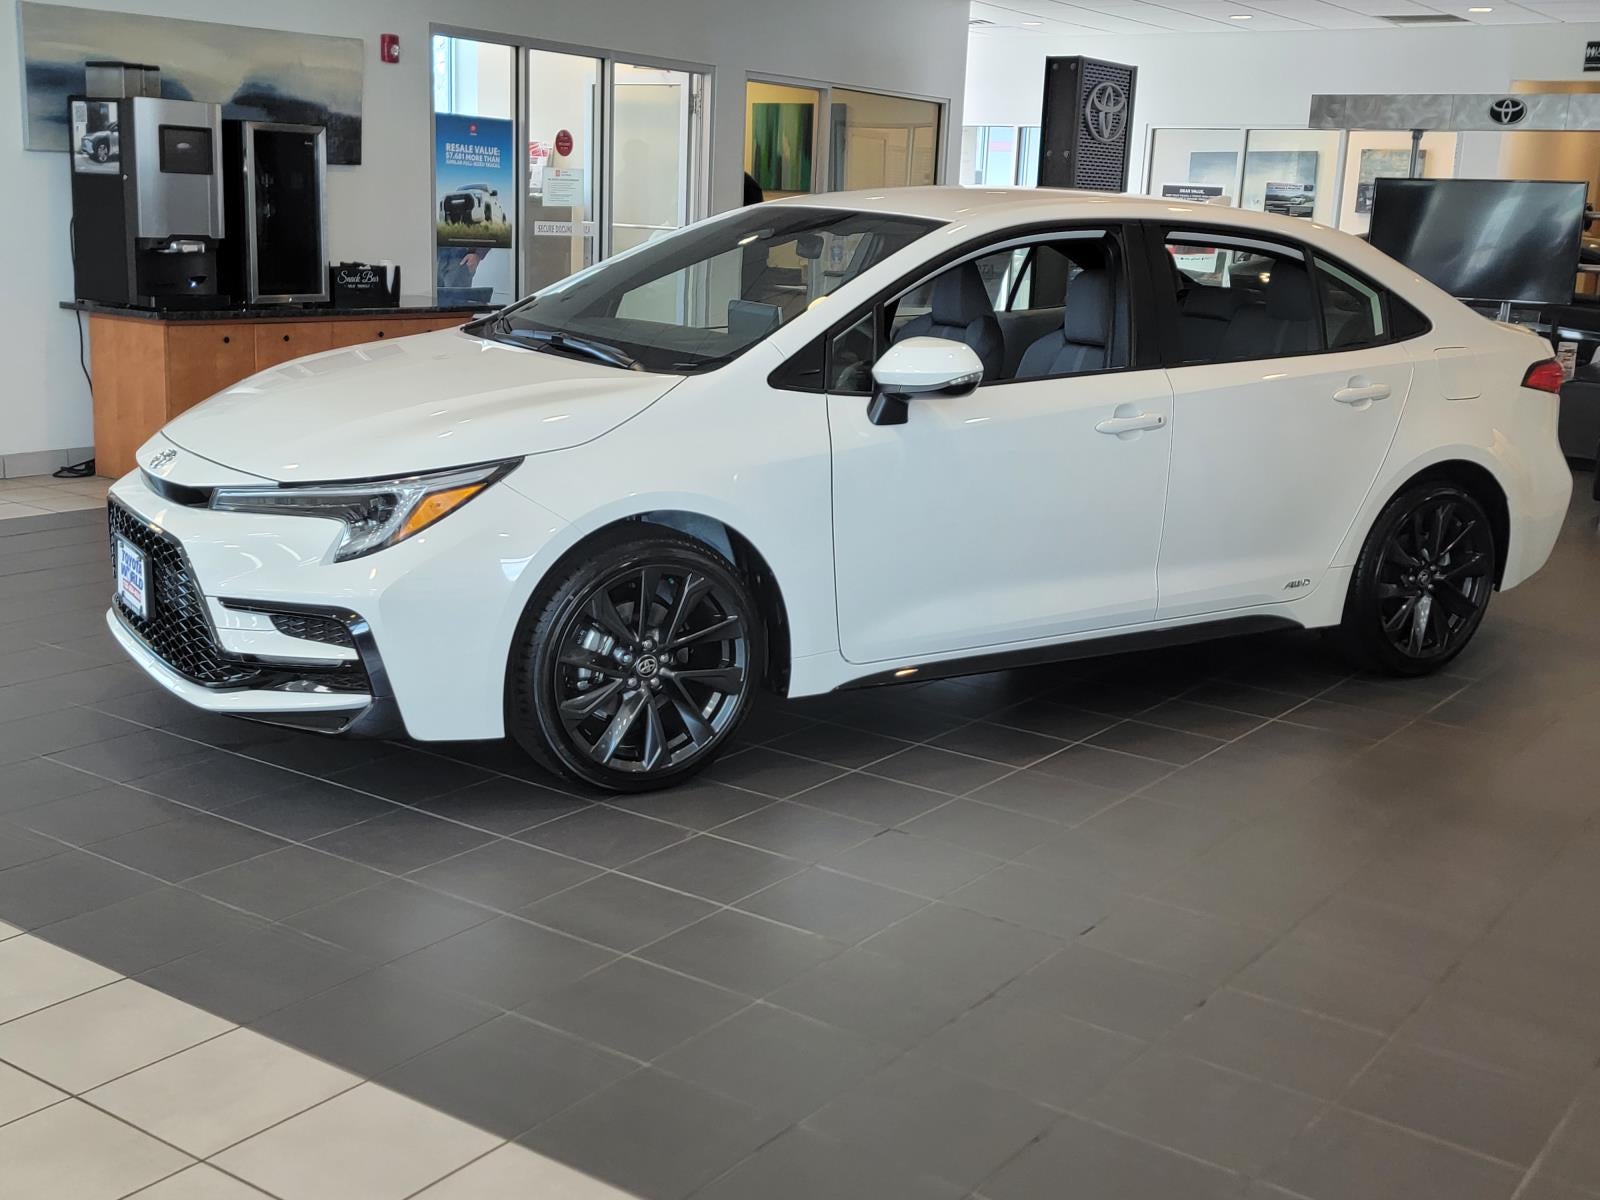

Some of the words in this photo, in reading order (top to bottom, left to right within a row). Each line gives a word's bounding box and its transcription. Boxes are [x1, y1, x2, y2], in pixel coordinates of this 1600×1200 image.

[446, 143, 471, 154] RESALE
[474, 146, 500, 156] VALUE:
[465, 154, 483, 162] MORE
[537, 224, 555, 233] SECURE
[337, 271, 360, 284] Snack
[361, 271, 379, 283] Bar
[122, 550, 142, 575] TOYOTA
